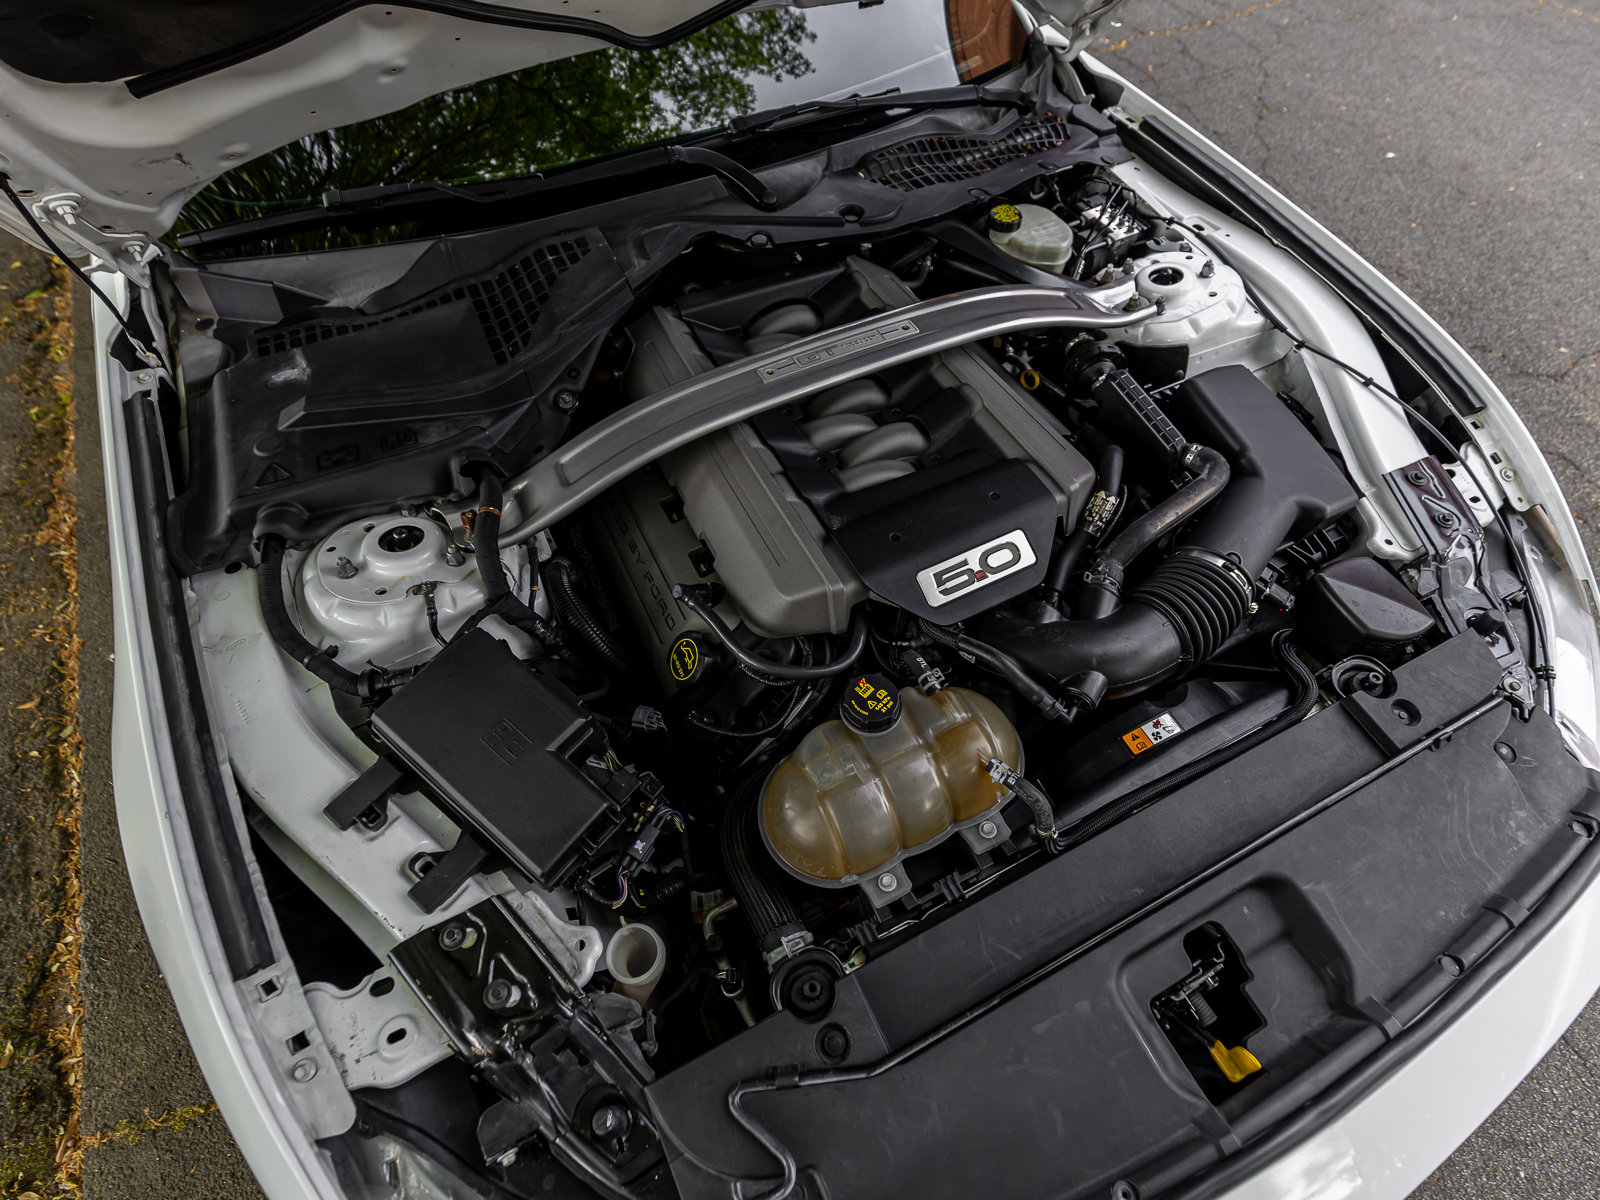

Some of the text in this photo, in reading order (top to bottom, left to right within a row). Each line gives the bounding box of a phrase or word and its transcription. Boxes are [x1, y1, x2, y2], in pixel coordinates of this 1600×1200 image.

[627, 539, 646, 566] BY
[643, 570, 676, 632] FORD
[932, 541, 1022, 597] 5.0
